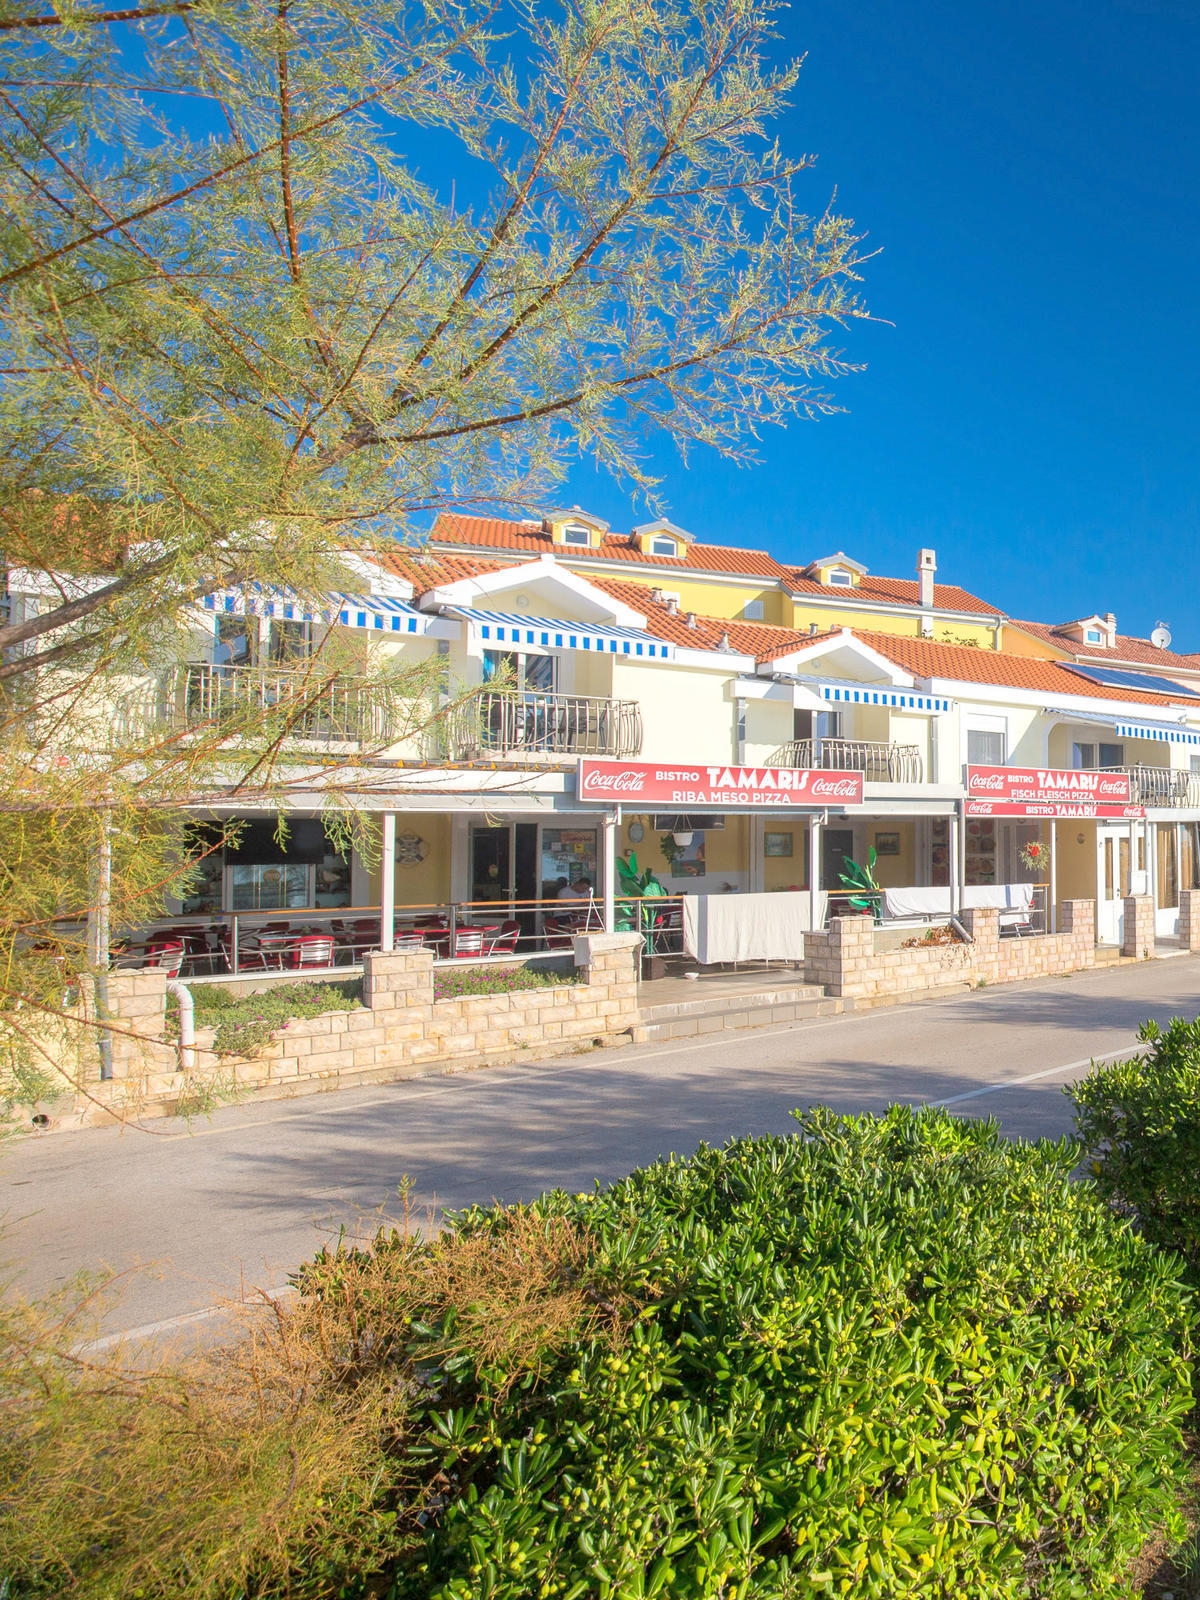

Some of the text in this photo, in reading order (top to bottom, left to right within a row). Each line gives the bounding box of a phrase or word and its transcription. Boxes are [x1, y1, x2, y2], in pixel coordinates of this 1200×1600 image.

[584, 770, 647, 791] Coca-Cola
[655, 767, 809, 790] BISTRO TAMARIS
[811, 778, 859, 797] Coca-Cola
[1007, 771, 1099, 790] BISTRO TAMARIS
[672, 790, 791, 803] RIBA MESO PIZZA
[1010, 789, 1095, 800] FISCH FLEISCH PIZZA
[1025, 805, 1097, 816] BISTRO TAMARIS
